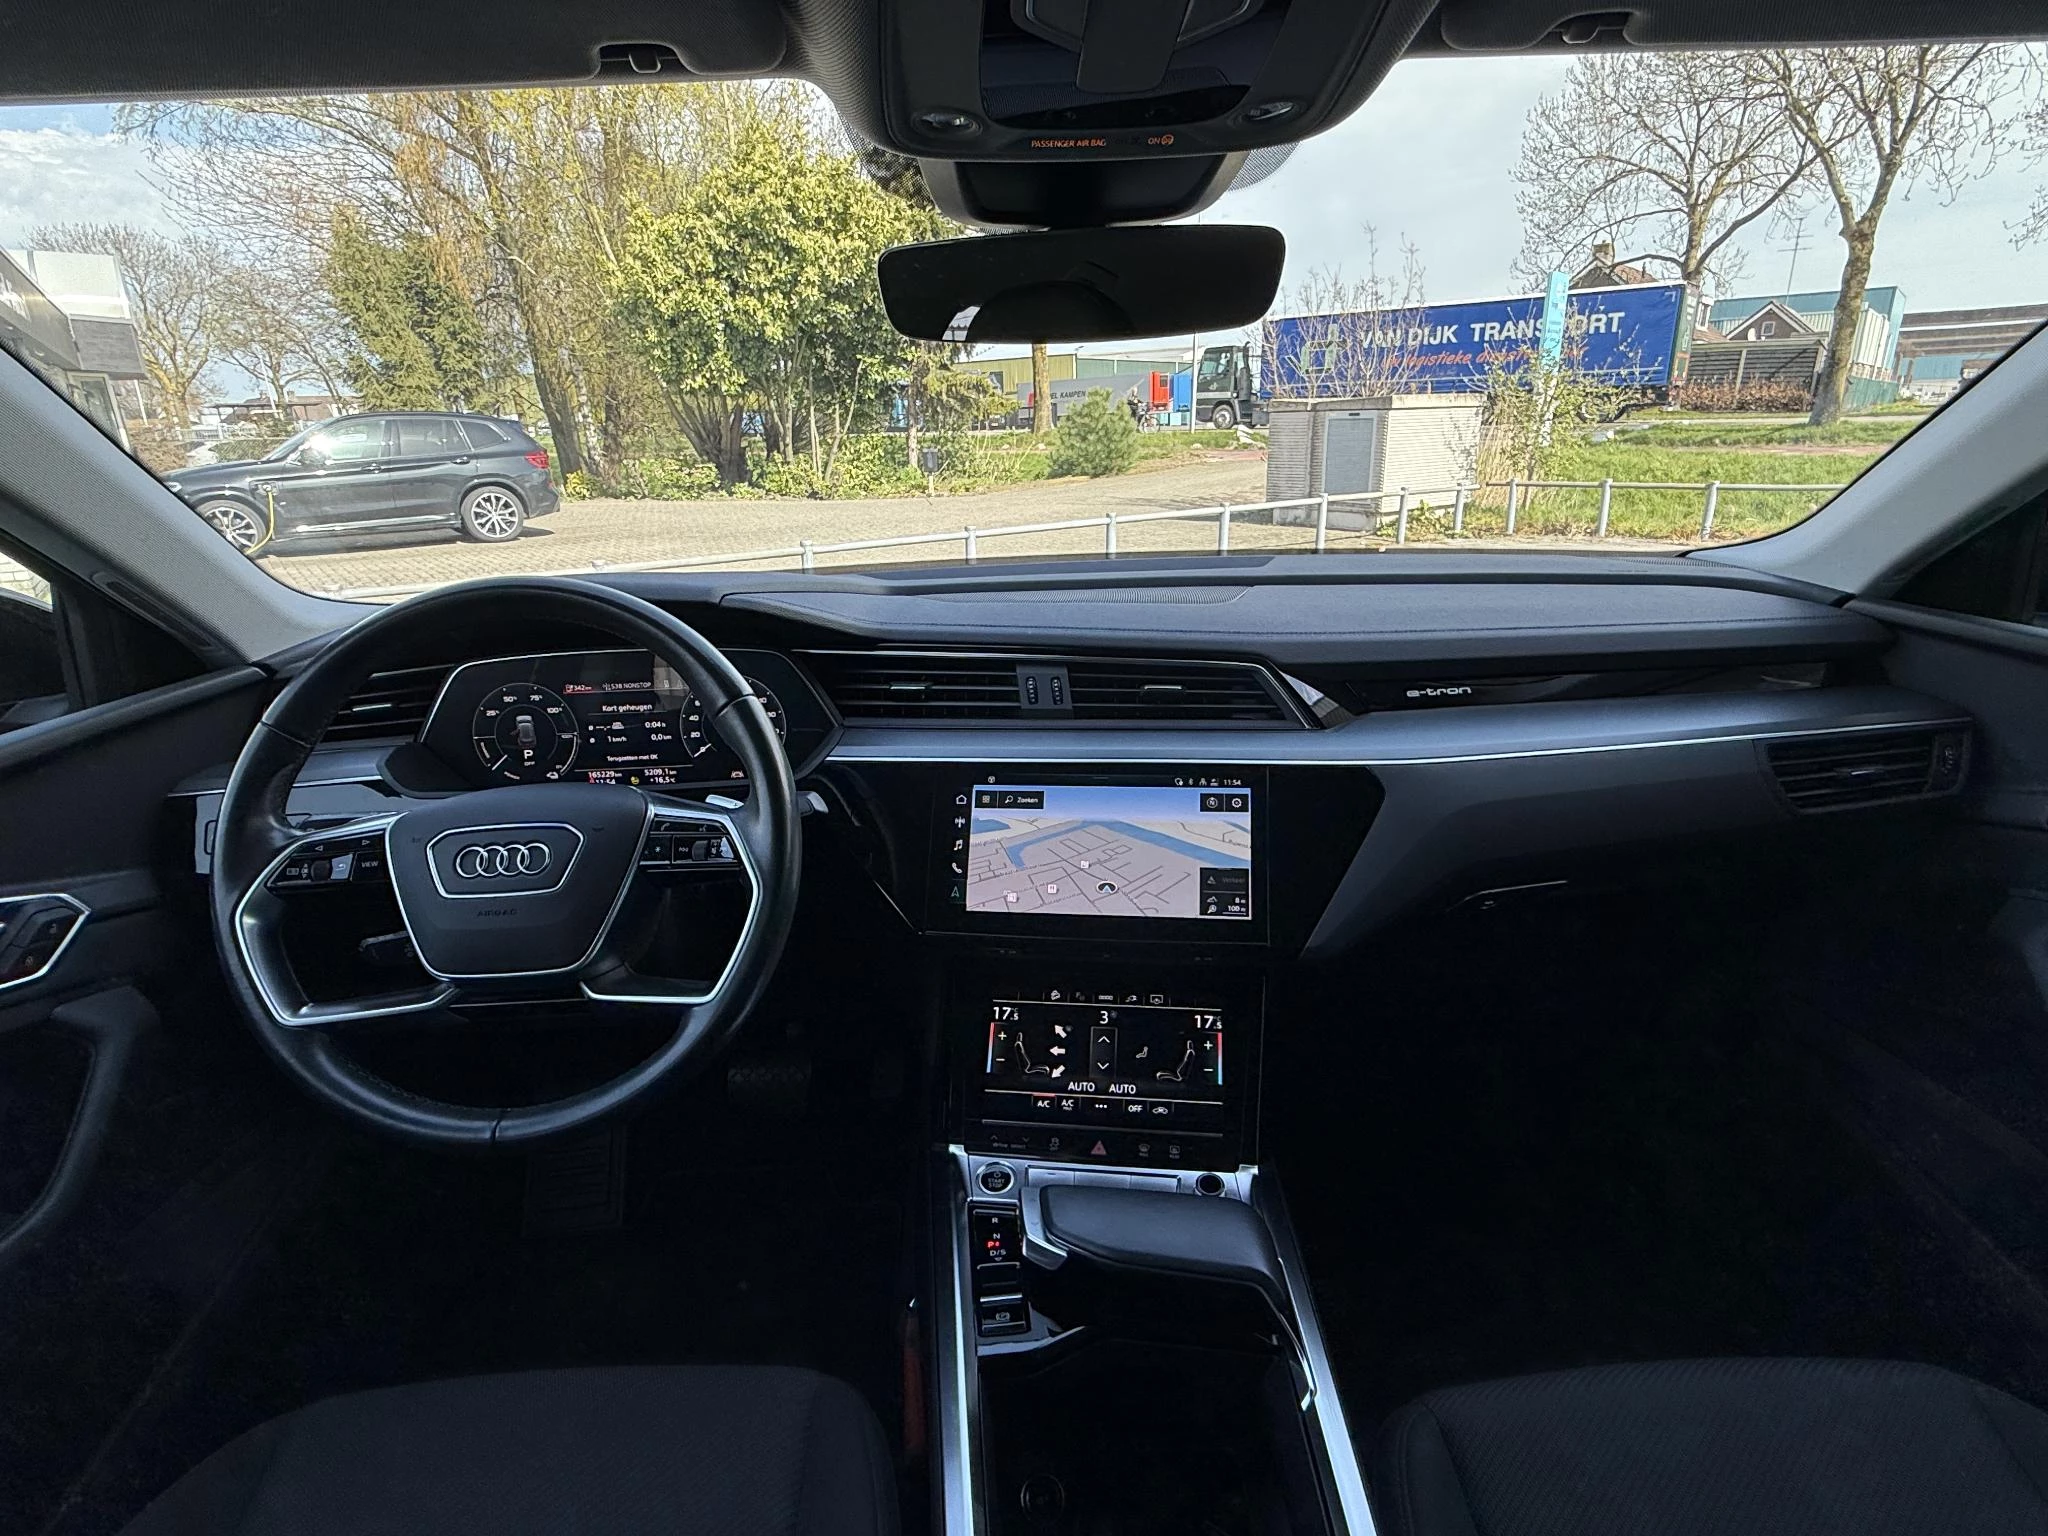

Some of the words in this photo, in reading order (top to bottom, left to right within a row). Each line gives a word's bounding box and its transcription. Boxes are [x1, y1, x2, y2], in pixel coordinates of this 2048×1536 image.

[1031, 139, 1075, 148] PASSENGER
[1147, 137, 1160, 145] ON
[1360, 327, 1401, 348] VAN
[1408, 324, 1458, 346] DIJK
[1470, 312, 1626, 343] TRANSORT
[1060, 390, 1086, 399] KAMPEN
[624, 681, 652, 689] NONSTOP
[1406, 686, 1472, 698] e-tron
[602, 704, 617, 712] Kort
[618, 704, 653, 713] geheugen
[523, 749, 534, 759] P
[588, 770, 615, 778] 165229
[1100, 1010, 1109, 1024] 3
[1068, 1082, 1095, 1092] AUTO
[1109, 1084, 1136, 1094] AUTO
[1037, 1100, 1050, 1108] A/C
[1061, 1099, 1074, 1107] A/C
